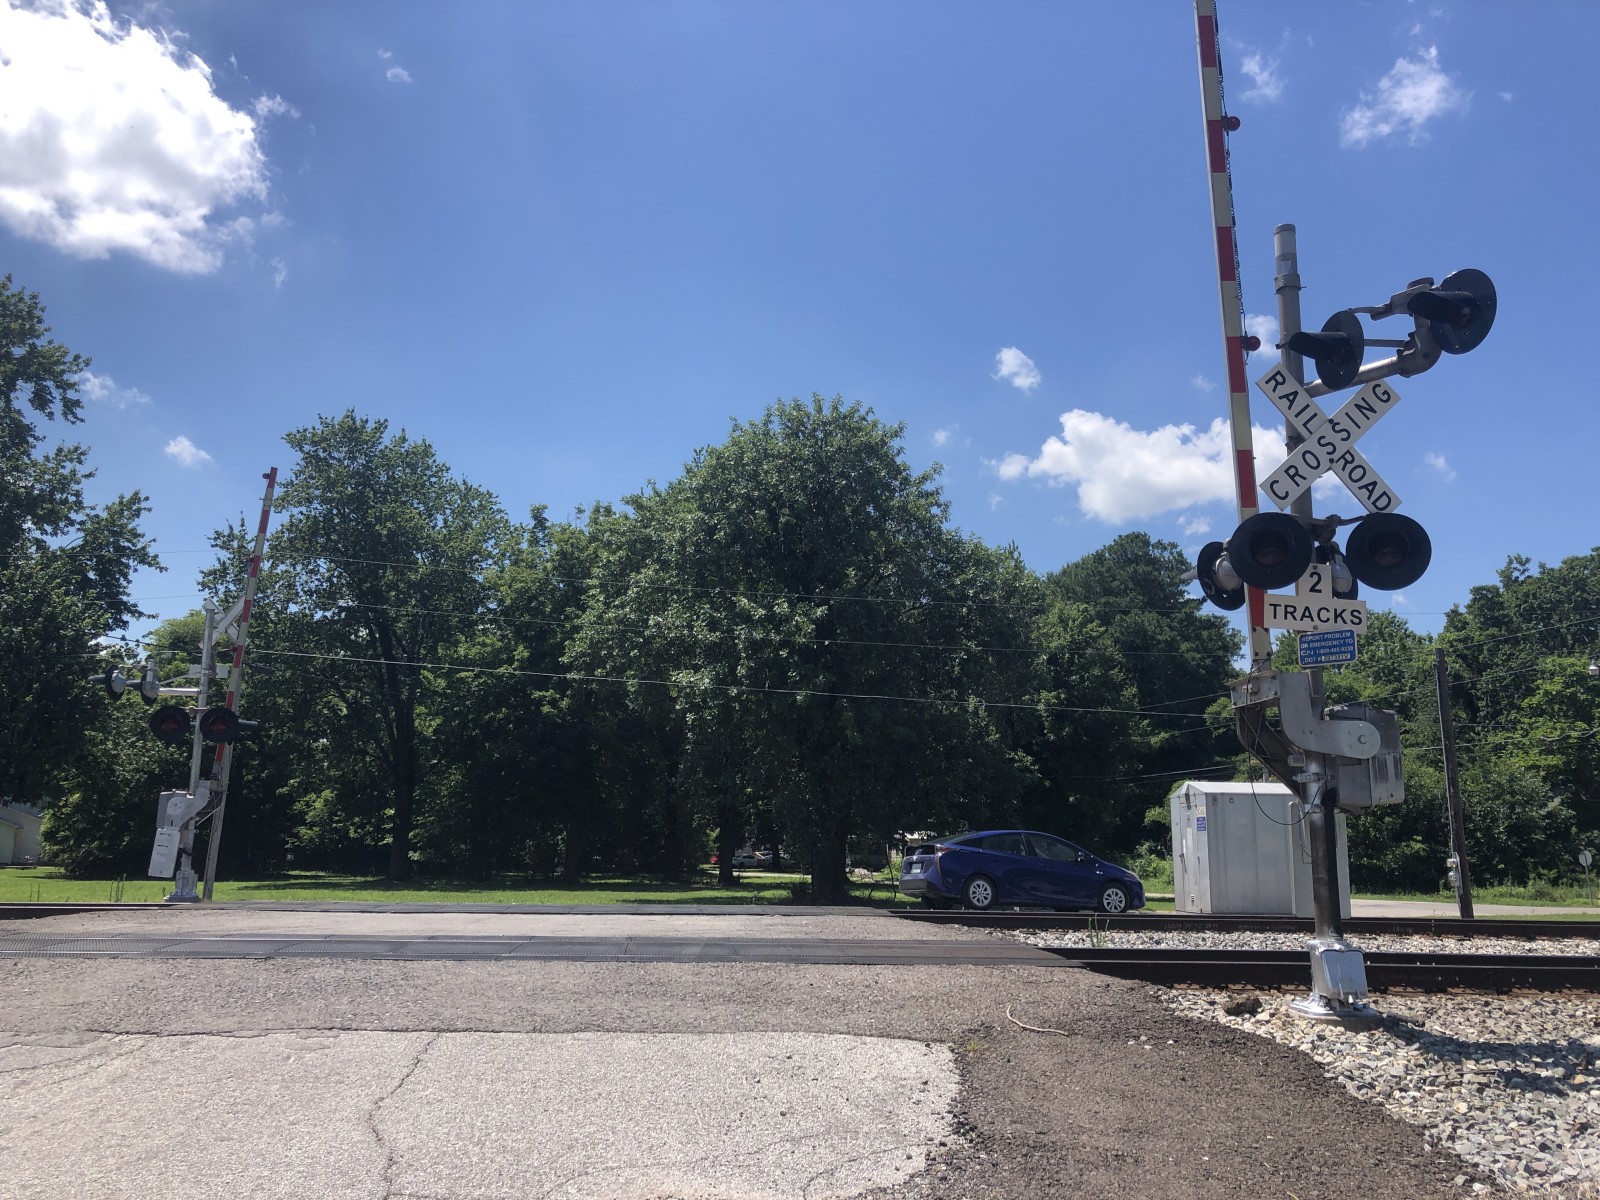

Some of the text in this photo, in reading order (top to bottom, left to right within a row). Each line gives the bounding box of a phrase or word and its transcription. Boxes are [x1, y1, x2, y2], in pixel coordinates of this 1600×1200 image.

[1265, 370, 1314, 435] RAIL
[1269, 382, 1393, 502] CROSSING
[1335, 449, 1393, 512] ROAD
[1308, 571, 1323, 594] 2
[1268, 603, 1363, 626] TRACKS
